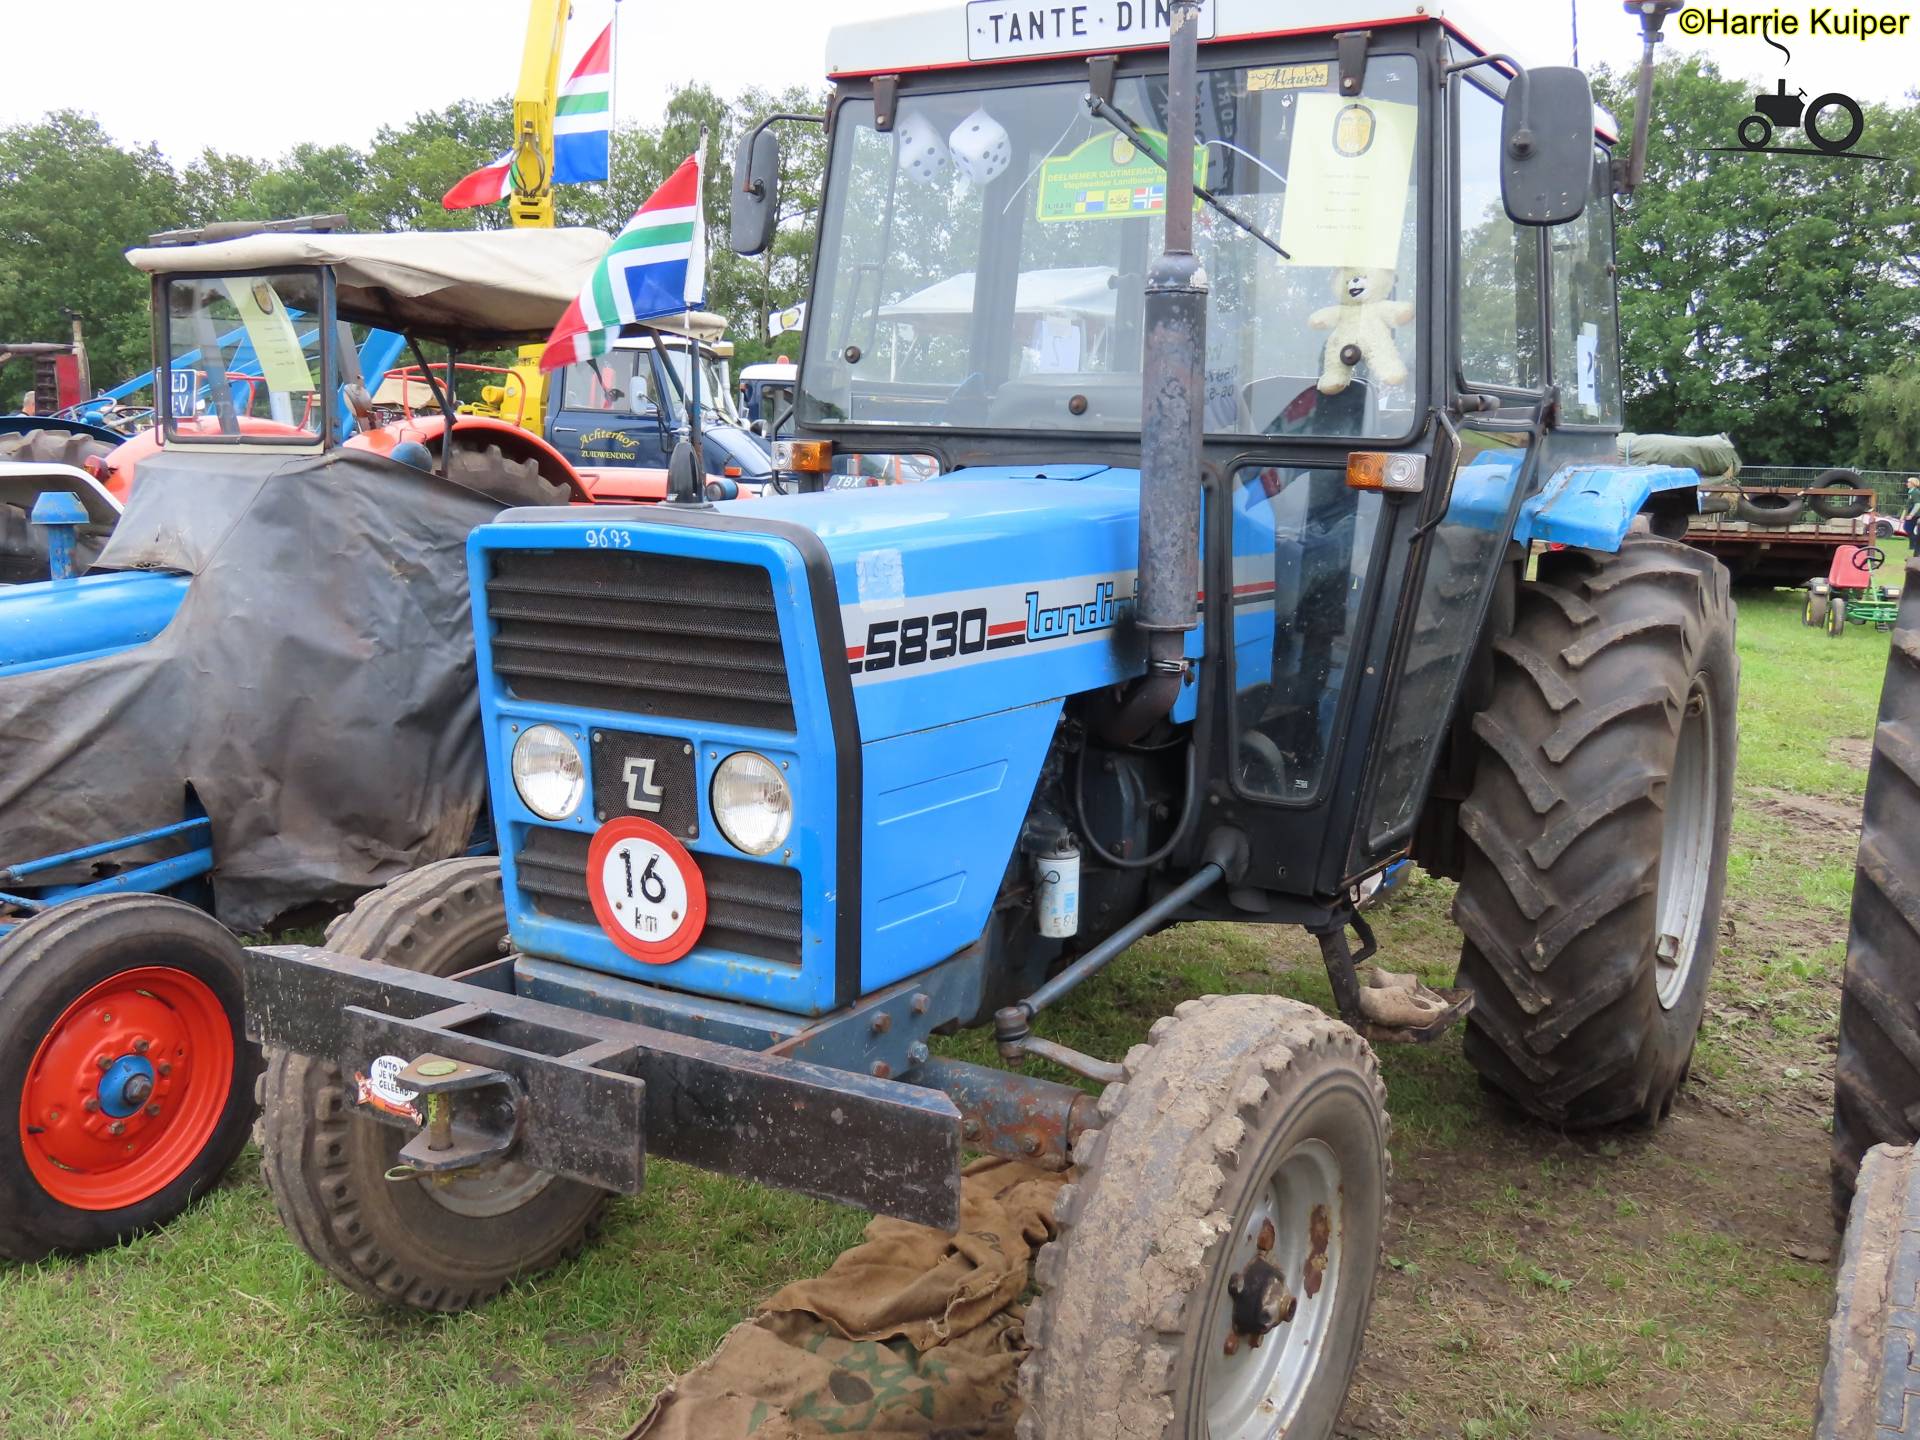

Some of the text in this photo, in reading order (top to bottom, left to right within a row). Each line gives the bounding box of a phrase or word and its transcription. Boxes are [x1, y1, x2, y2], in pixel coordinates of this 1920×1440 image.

[988, 0, 1171, 44] TANTE DIN
[579, 427, 640, 450] Achterhof
[581, 449, 636, 460] ZUIDWENDING
[835, 475, 863, 488] TBX
[585, 527, 632, 548] 9673
[864, 607, 988, 672] 5830
[619, 847, 667, 904] 16
[635, 906, 659, 933] km
[378, 1059, 398, 1072] AUTO
